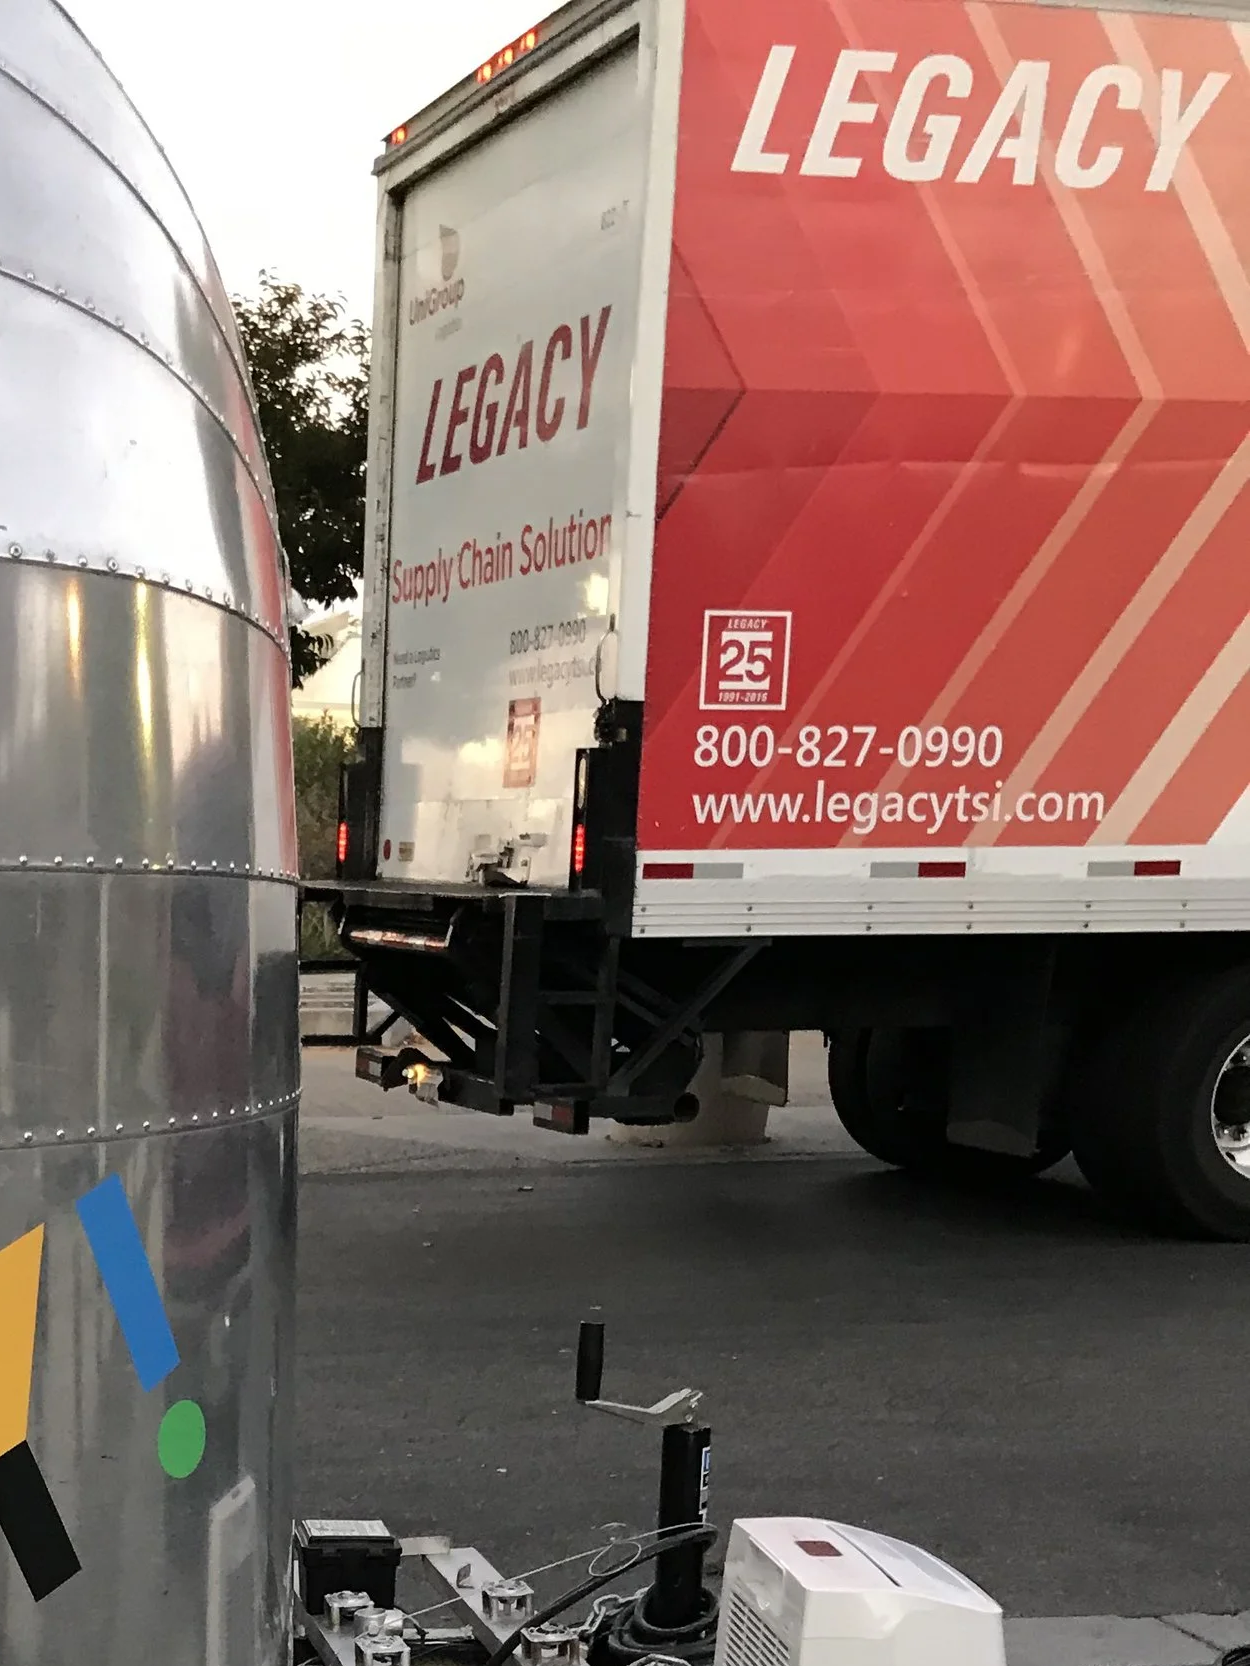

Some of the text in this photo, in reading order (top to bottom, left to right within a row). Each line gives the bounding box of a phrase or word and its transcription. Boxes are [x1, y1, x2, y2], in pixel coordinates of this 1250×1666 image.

[730, 44, 1232, 192] LEGACY
[416, 304, 613, 485] LEGACY
[392, 548, 453, 609] Supply
[458, 532, 513, 589] Chain
[510, 618, 587, 656] 800-827-0990
[727, 618, 768, 629] LEGACY
[719, 638, 773, 683] 25
[718, 691, 769, 703] 1991-2016
[693, 725, 1003, 768] 800-827-0990
[692, 780, 1105, 835] www.legacytsi.com
